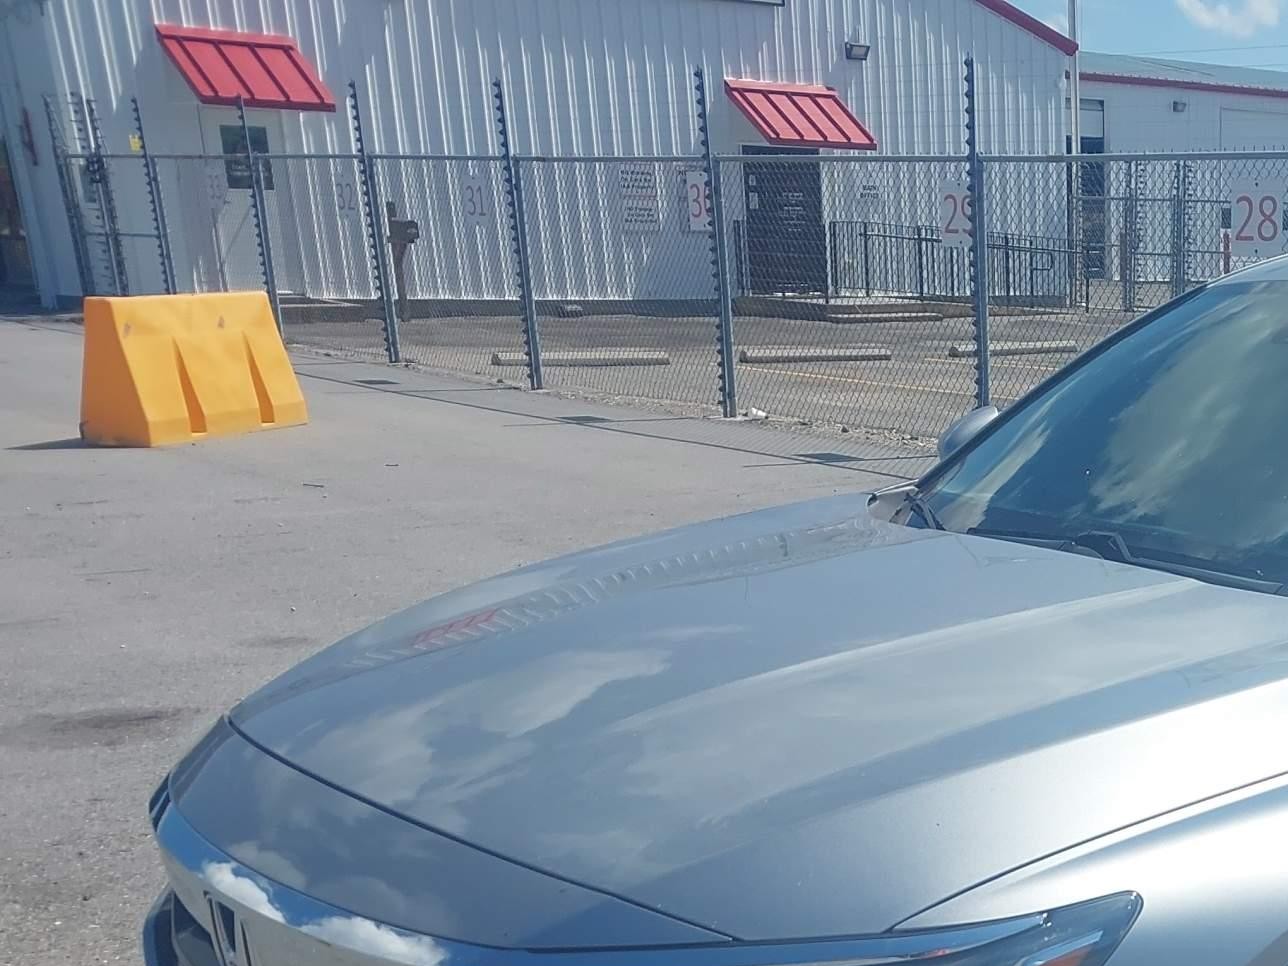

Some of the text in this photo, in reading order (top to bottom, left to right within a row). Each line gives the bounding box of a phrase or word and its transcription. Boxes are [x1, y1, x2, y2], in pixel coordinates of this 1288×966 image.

[336, 183, 356, 210] 32
[465, 185, 486, 216] 31
[1235, 195, 1279, 242] 28
